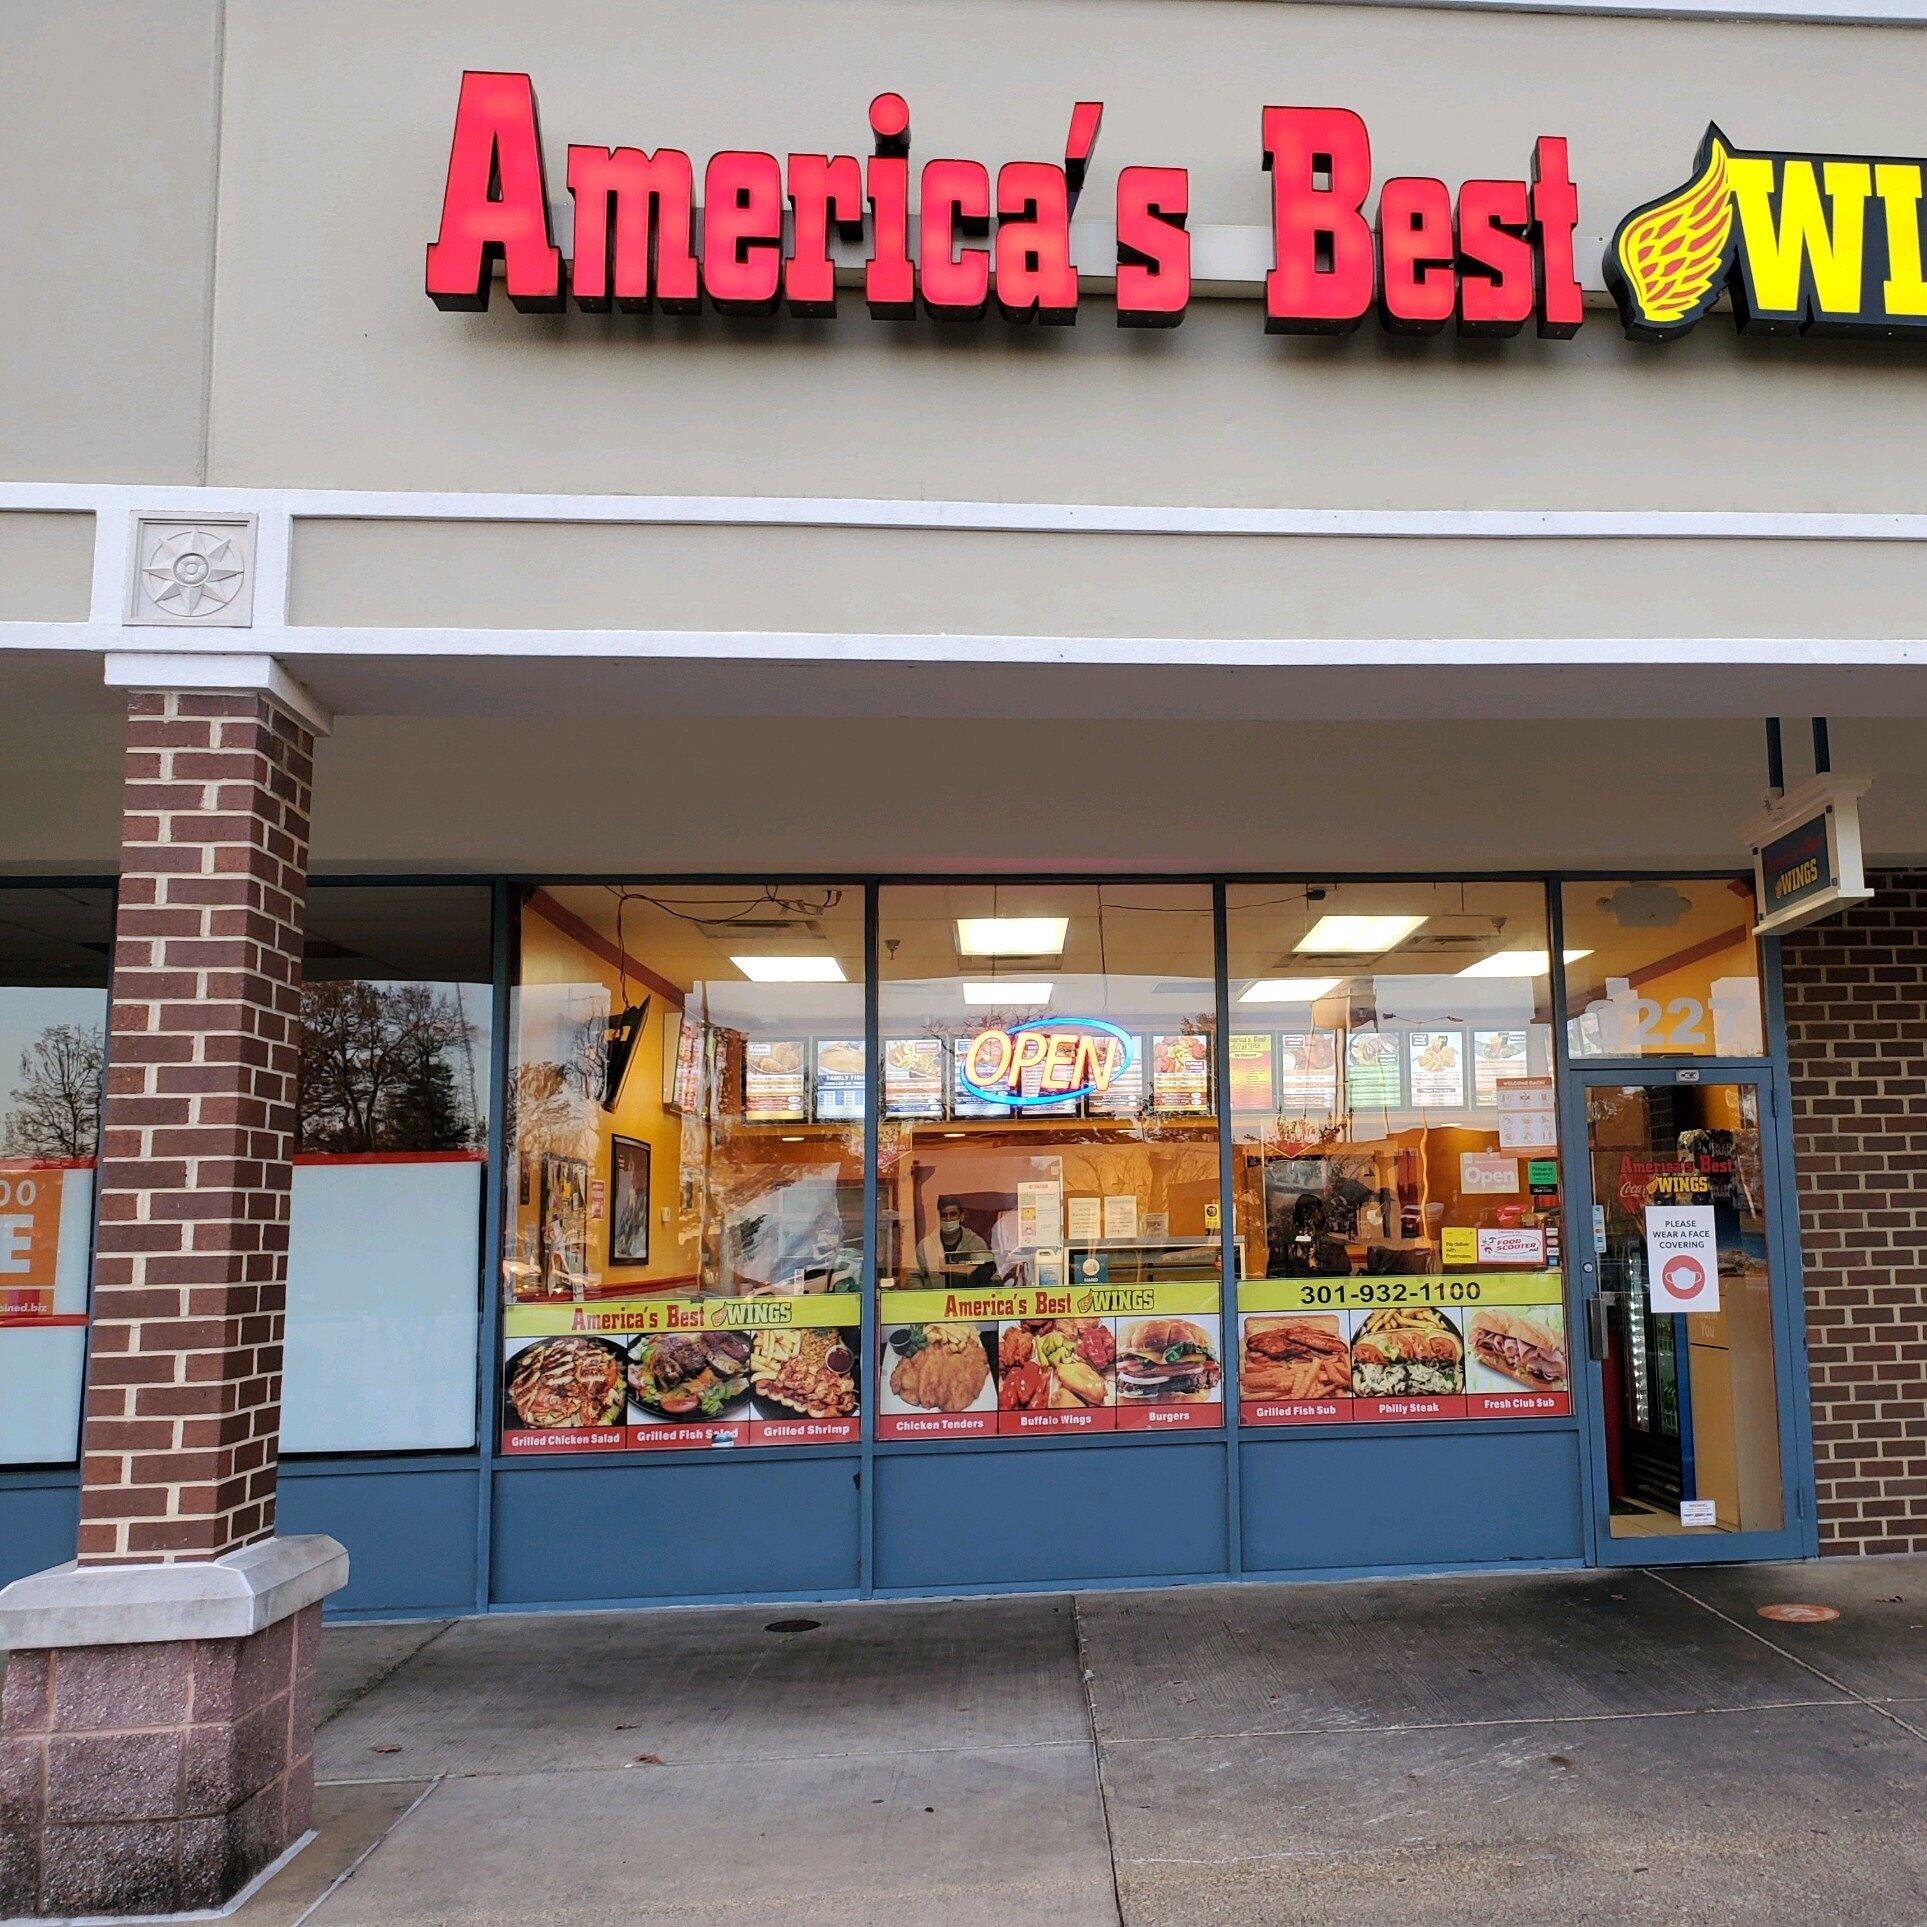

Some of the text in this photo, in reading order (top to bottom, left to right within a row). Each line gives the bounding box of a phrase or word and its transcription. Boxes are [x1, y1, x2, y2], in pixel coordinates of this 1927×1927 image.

[425, 71, 1191, 318] America's
[1262, 105, 1584, 325] Best
[1780, 857, 1818, 896] WINGS
[965, 1030, 1118, 1091] OPEN
[1620, 1153, 1733, 1174] America's Best
[1464, 1166, 1515, 1188] Open
[1657, 1176, 1709, 1193] WINGS
[1664, 1220, 1697, 1228] PLEASE
[1652, 1230, 1711, 1238] WEAR A FACE
[1496, 1238, 1522, 1246] FOOD
[1496, 1243, 1537, 1251] SCOOTER
[1659, 1241, 1705, 1249] COVERING
[1300, 1282, 1482, 1305] 301-932-1100
[944, 1288, 1155, 1318] America's Best WINGS
[571, 1301, 793, 1331] America's Best WINGS
[1379, 1401, 1440, 1415] Philly Steak
[1484, 1397, 1555, 1410] Fresh Club Sub
[1149, 1410, 1190, 1423] Burgers
[1256, 1404, 1337, 1418] Grilled Fish Sub
[896, 1418, 984, 1432] Chicken Tenders
[1020, 1413, 1092, 1427] Buffalo Wings
[636, 1429, 678, 1442] Grilled
[678, 1428, 704, 1441] Fish
[763, 1423, 850, 1437] Grilled Shrimp
[511, 1432, 620, 1448] Grilled Chicken Salad
